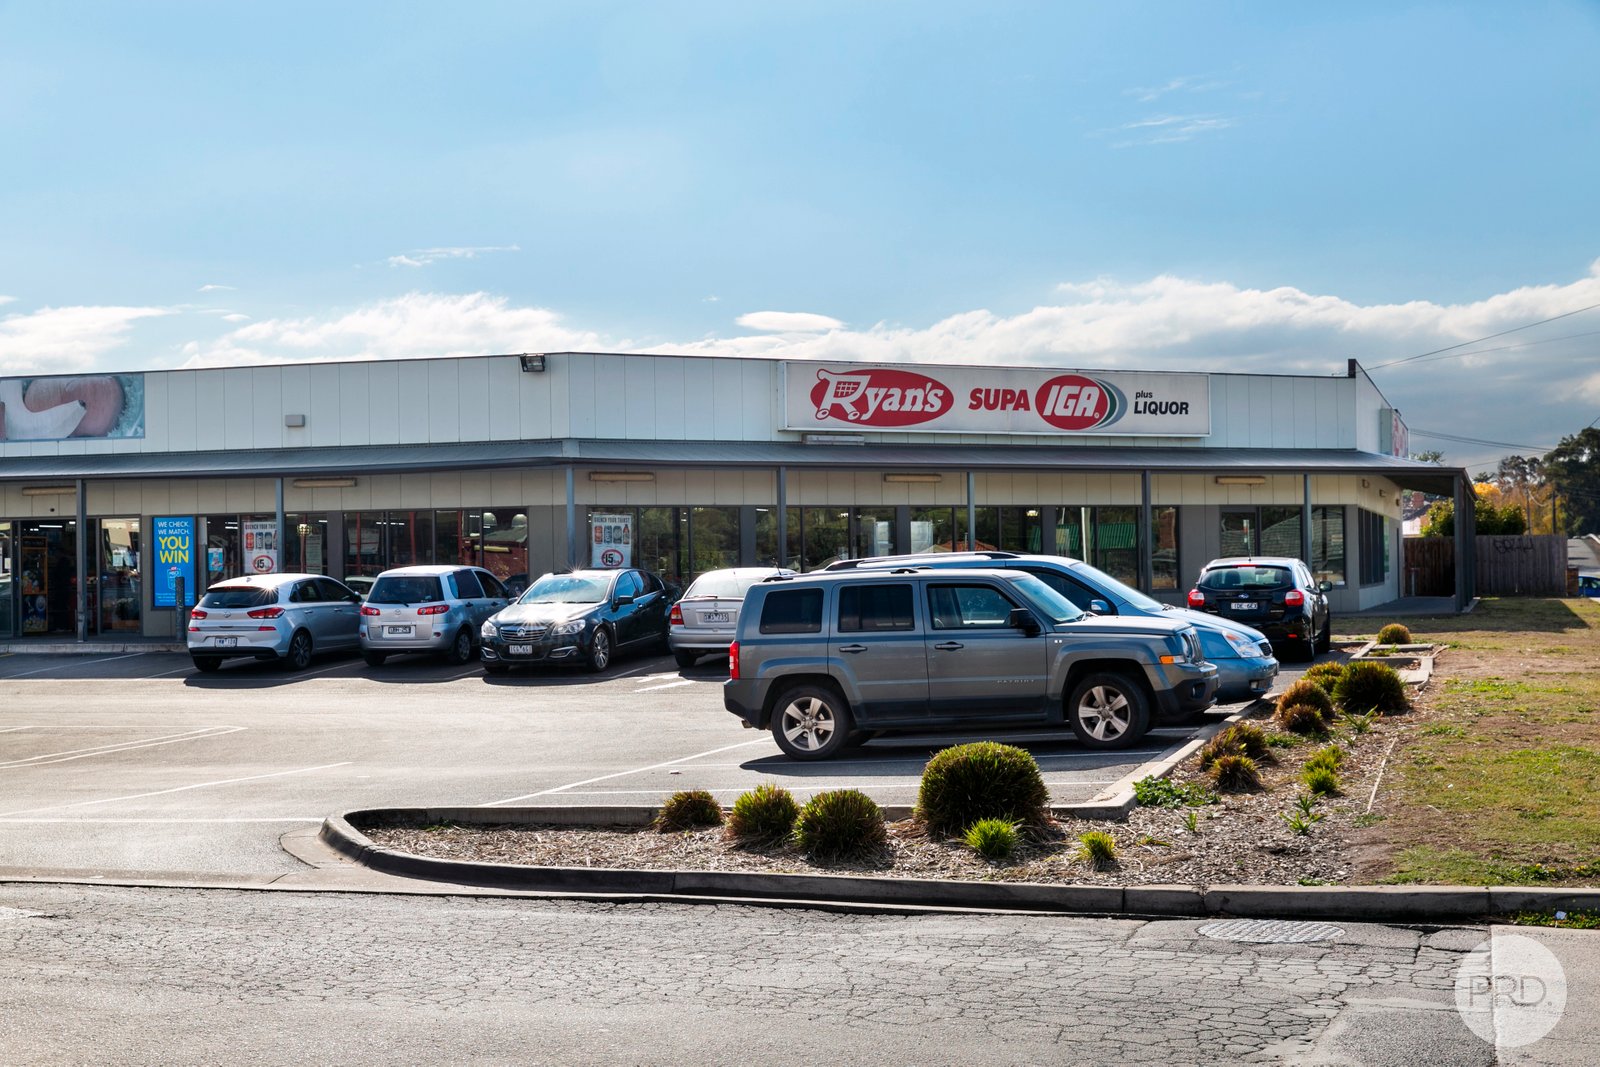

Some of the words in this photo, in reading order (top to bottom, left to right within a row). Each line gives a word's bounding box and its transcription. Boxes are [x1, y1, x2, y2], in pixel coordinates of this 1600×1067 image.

[816, 368, 944, 420] Ryan's
[968, 388, 1030, 411] SUPA
[1043, 385, 1099, 417] IGA
[1135, 390, 1153, 400] plus
[1134, 401, 1189, 415] LIQUOR
[159, 535, 189, 550] YOU
[159, 550, 189, 564] WIN
